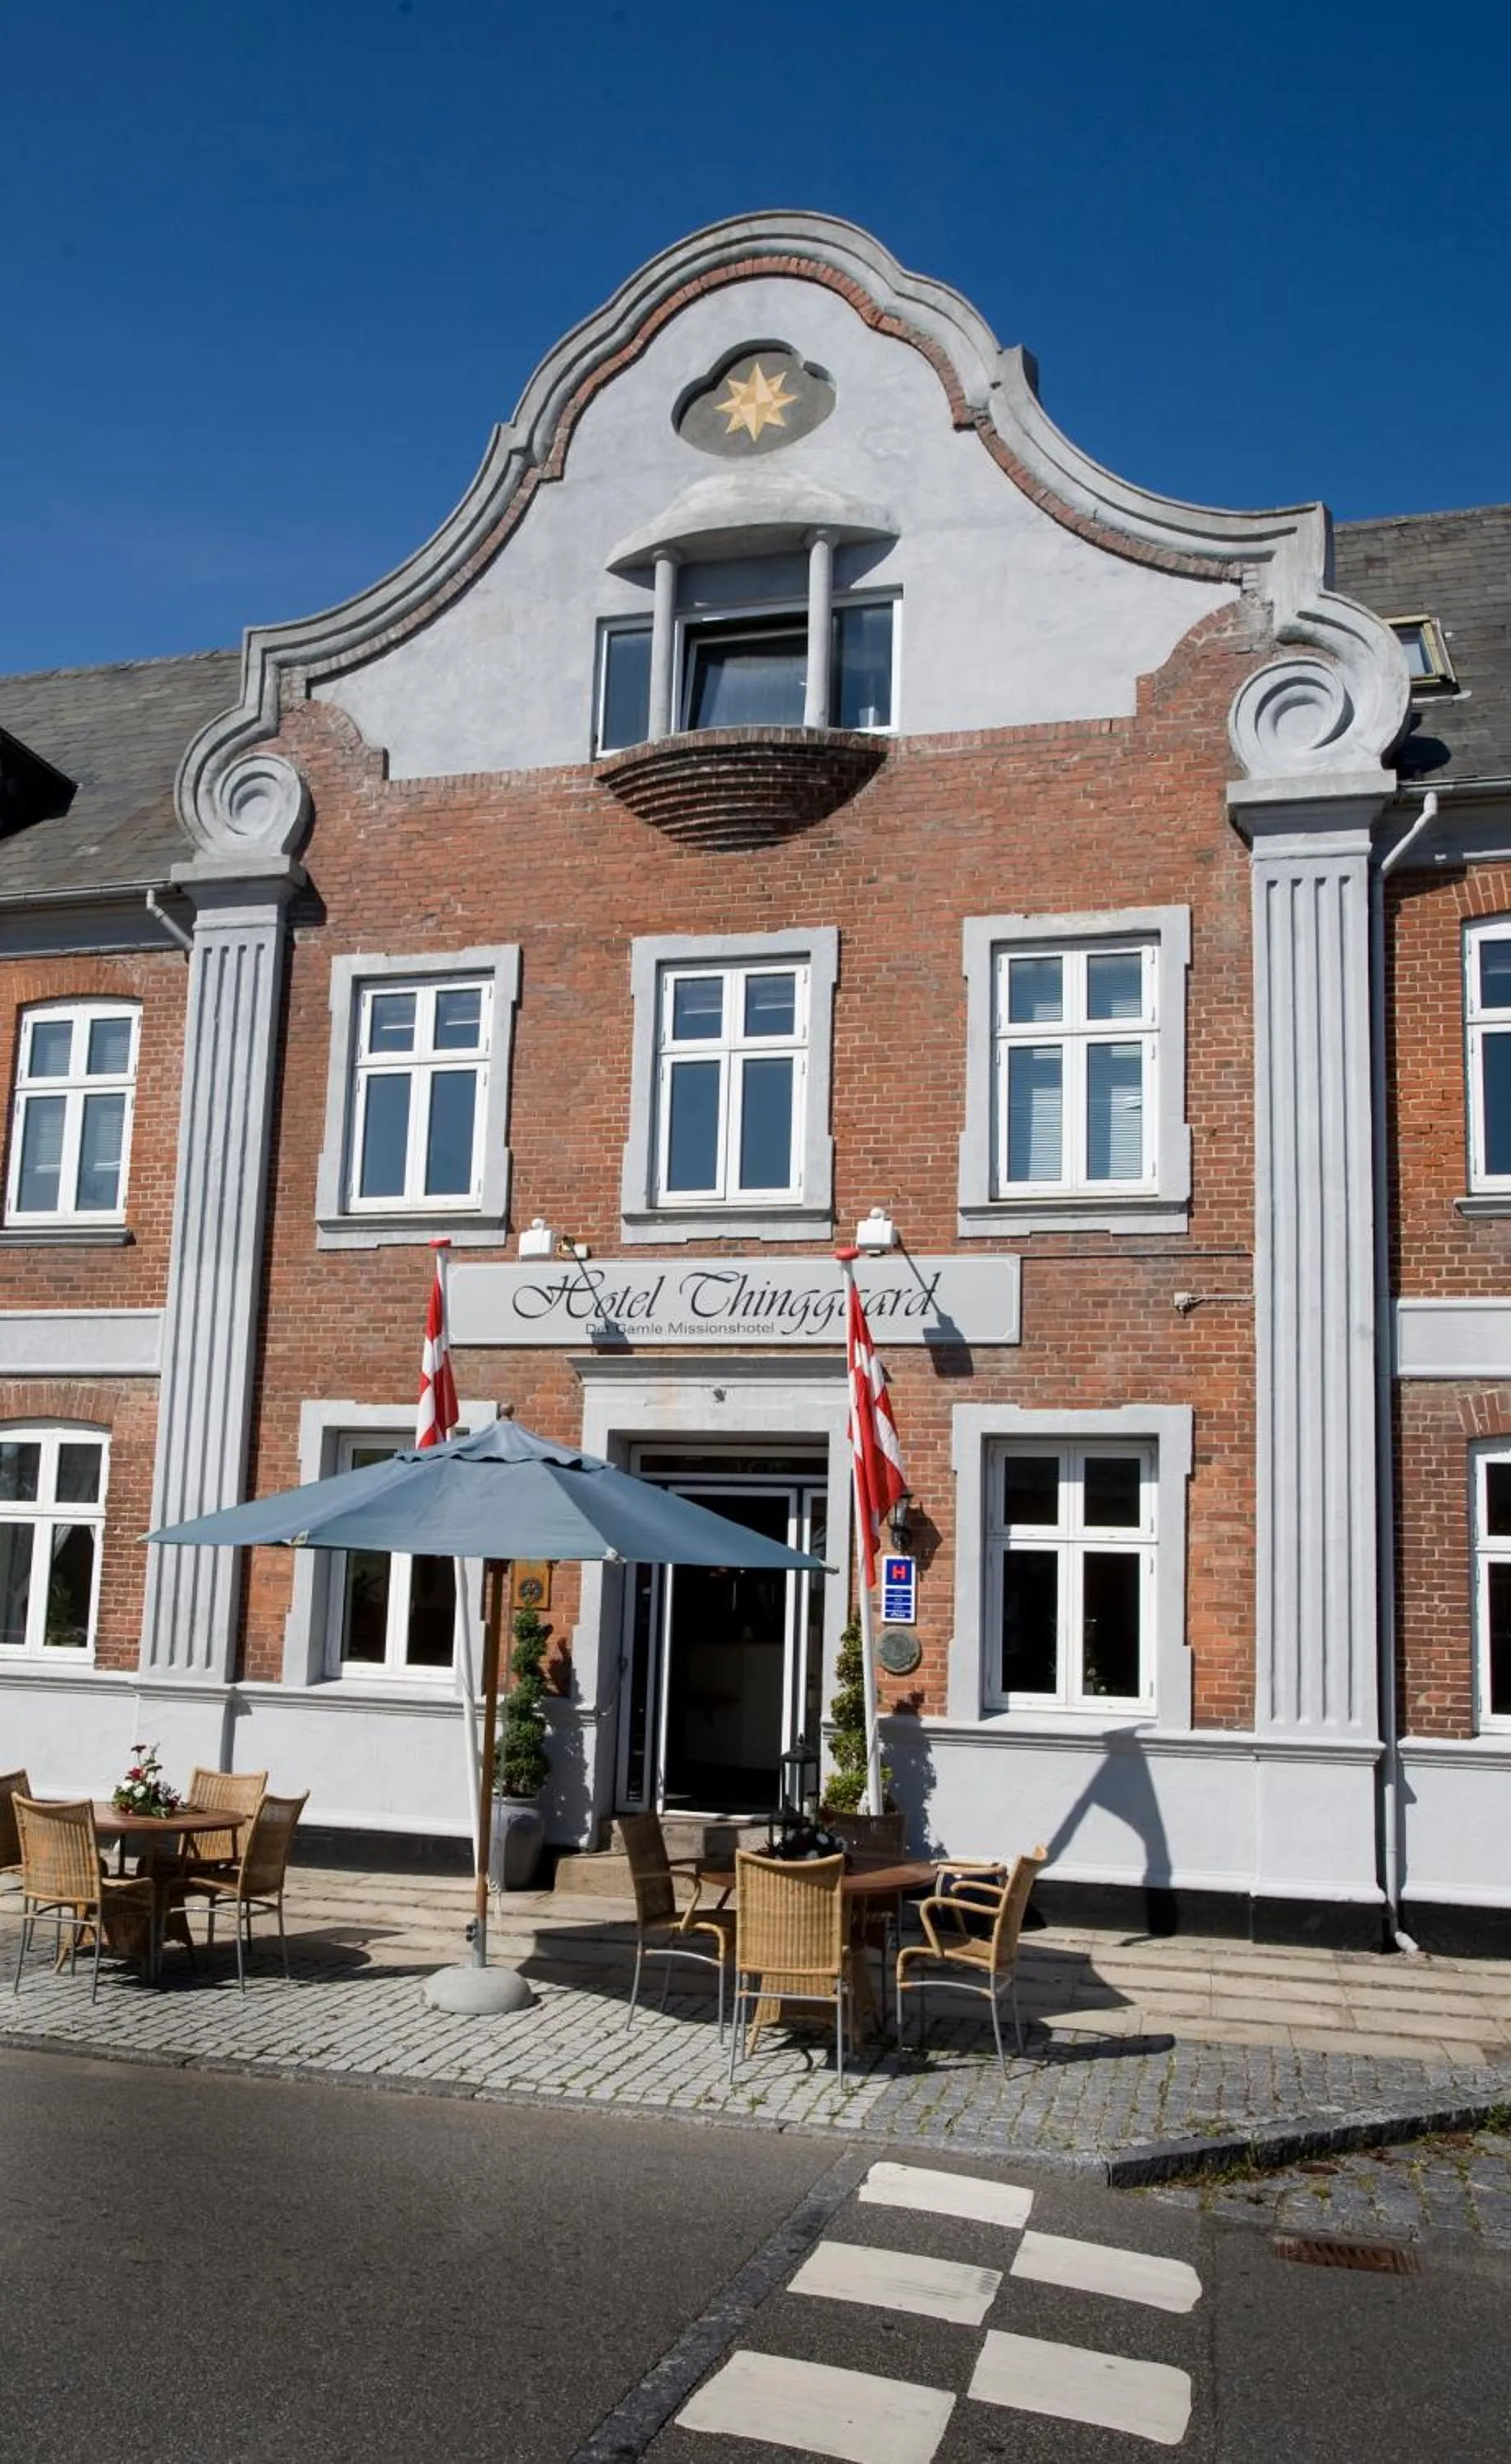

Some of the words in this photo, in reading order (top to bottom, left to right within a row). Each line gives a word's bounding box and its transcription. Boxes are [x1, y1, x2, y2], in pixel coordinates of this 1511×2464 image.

[512, 1269, 666, 1319] Hotel
[616, 1322, 663, 1335] Gamle
[668, 1322, 774, 1335] Missionshotel
[893, 1565, 906, 1580] H
